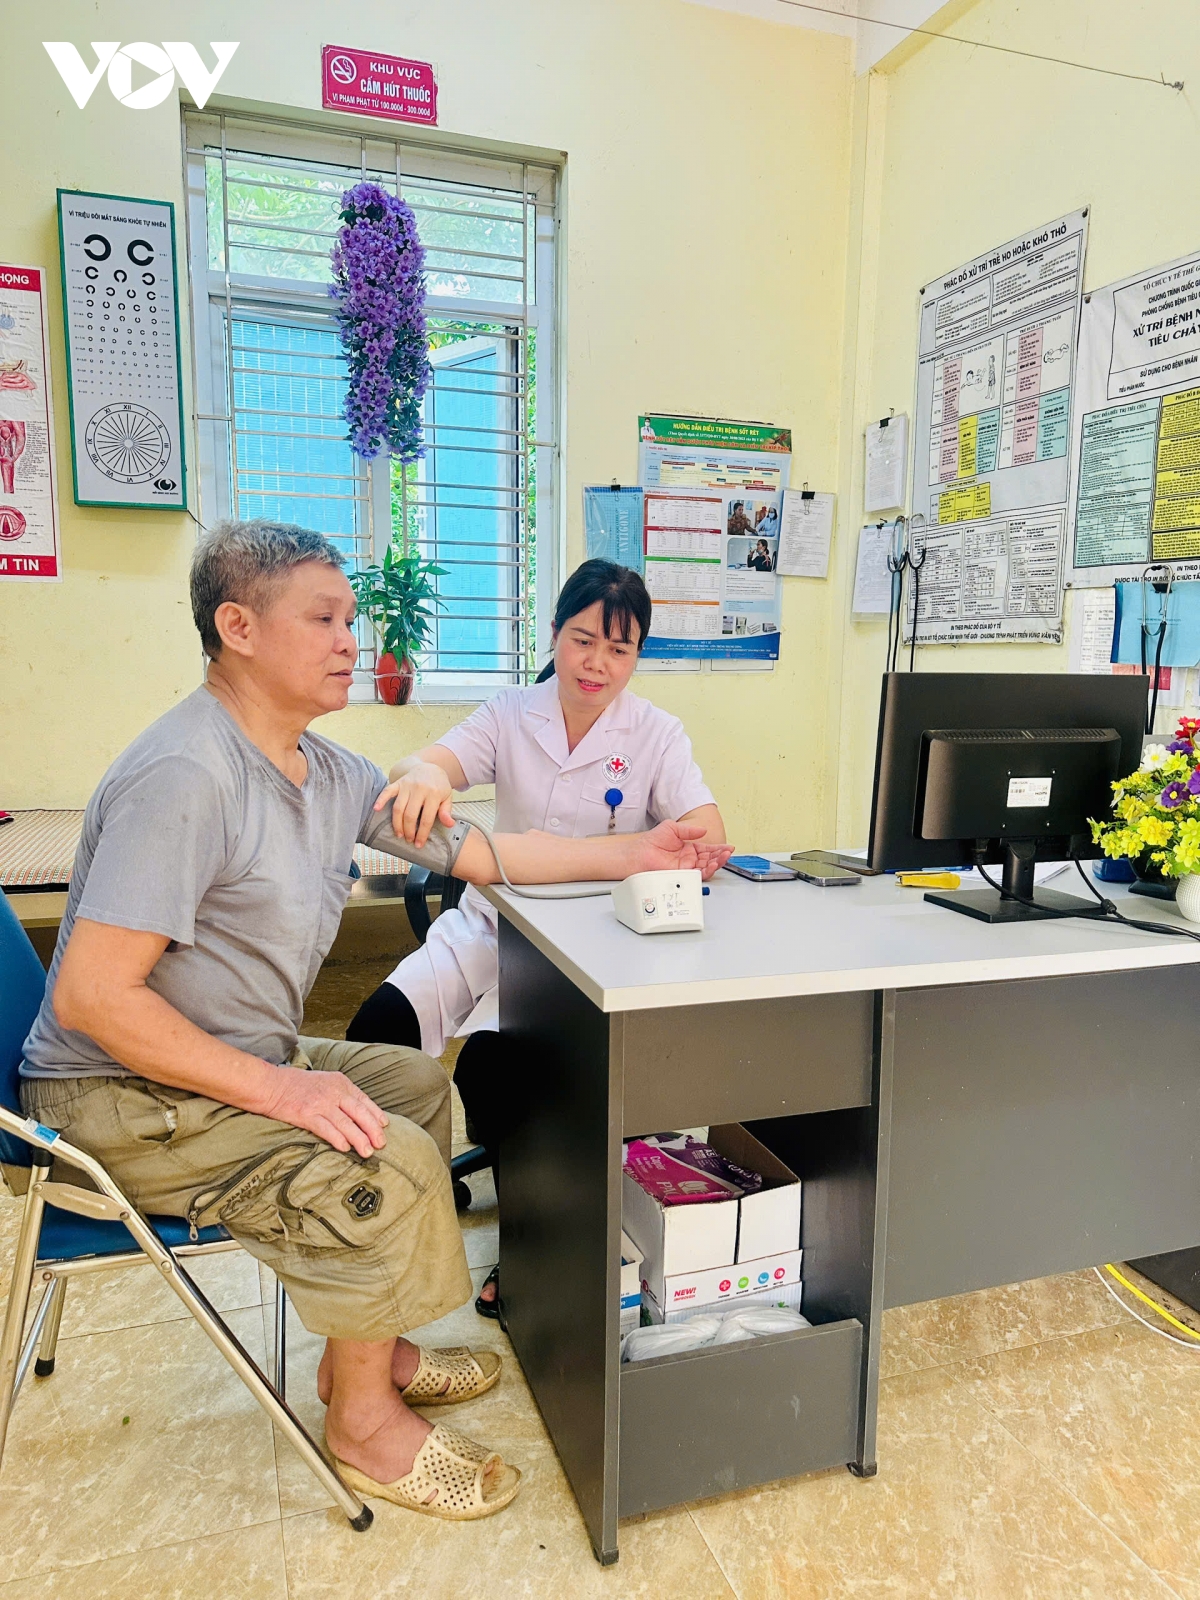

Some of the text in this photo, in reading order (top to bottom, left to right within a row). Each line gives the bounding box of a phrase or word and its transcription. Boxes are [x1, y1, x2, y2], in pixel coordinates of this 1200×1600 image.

[370, 62, 421, 80] KHU VỰC
[360, 76, 430, 103] CẤM HÚT THUỐC
[943, 222, 1067, 290] PHÁC ĐỒ XỬ TRÍ TRẺ HO HOẶC KHÓ THỞ
[1167, 287, 1181, 297] TRÌNH
[1181, 281, 1194, 292] QUỐC
[1158, 300, 1174, 312] CHỐNG
[1174, 297, 1187, 307] BỆNH
[1132, 323, 1146, 338] XỬ
[1146, 318, 1164, 333] TRÍ
[1166, 310, 1193, 327] BỆNH
[1148, 333, 1170, 347] TIÊU
[1161, 363, 1171, 372] CHO
[1172, 359, 1184, 370] BỆNH
[12, 558, 39, 571] TIN
[674, 1287, 697, 1298] NEW!
